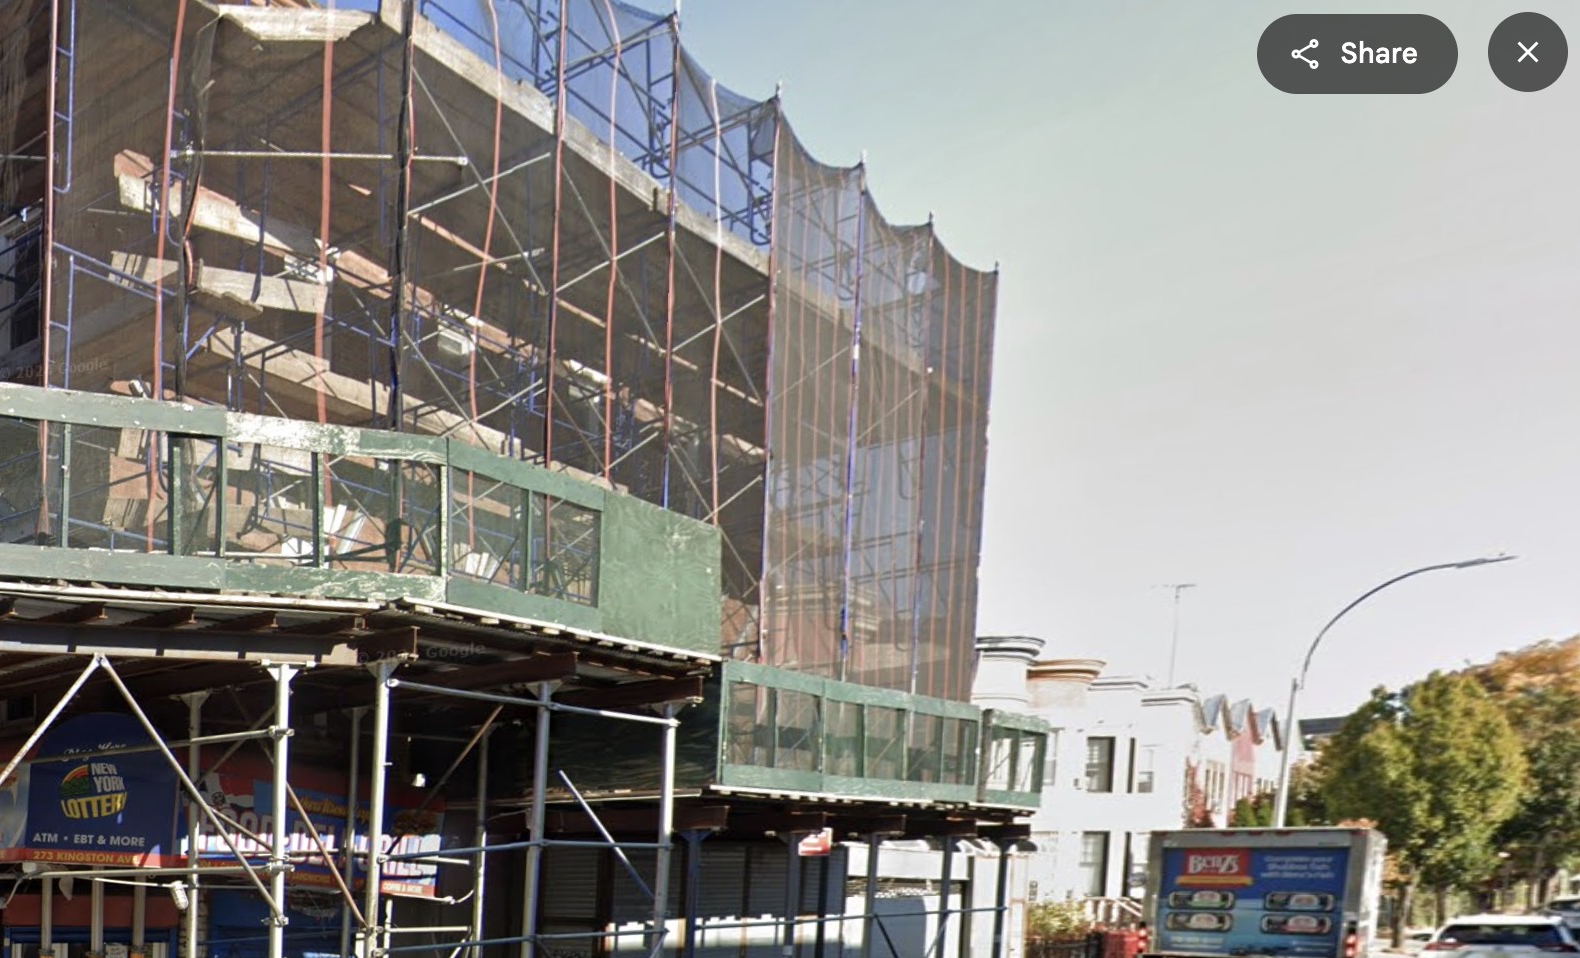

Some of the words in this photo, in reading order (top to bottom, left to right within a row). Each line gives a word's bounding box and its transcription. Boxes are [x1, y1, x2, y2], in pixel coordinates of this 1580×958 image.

[91, 762, 118, 776] NEW
[93, 776, 126, 794] YORK
[60, 791, 128, 820] LOTTERY
[32, 833, 59, 844] ATM
[73, 834, 95, 845] EBT
[96, 835, 108, 846] &
[109, 836, 146, 848] MORE
[32, 850, 54, 861] 273
[56, 851, 114, 864] KINGSTON
